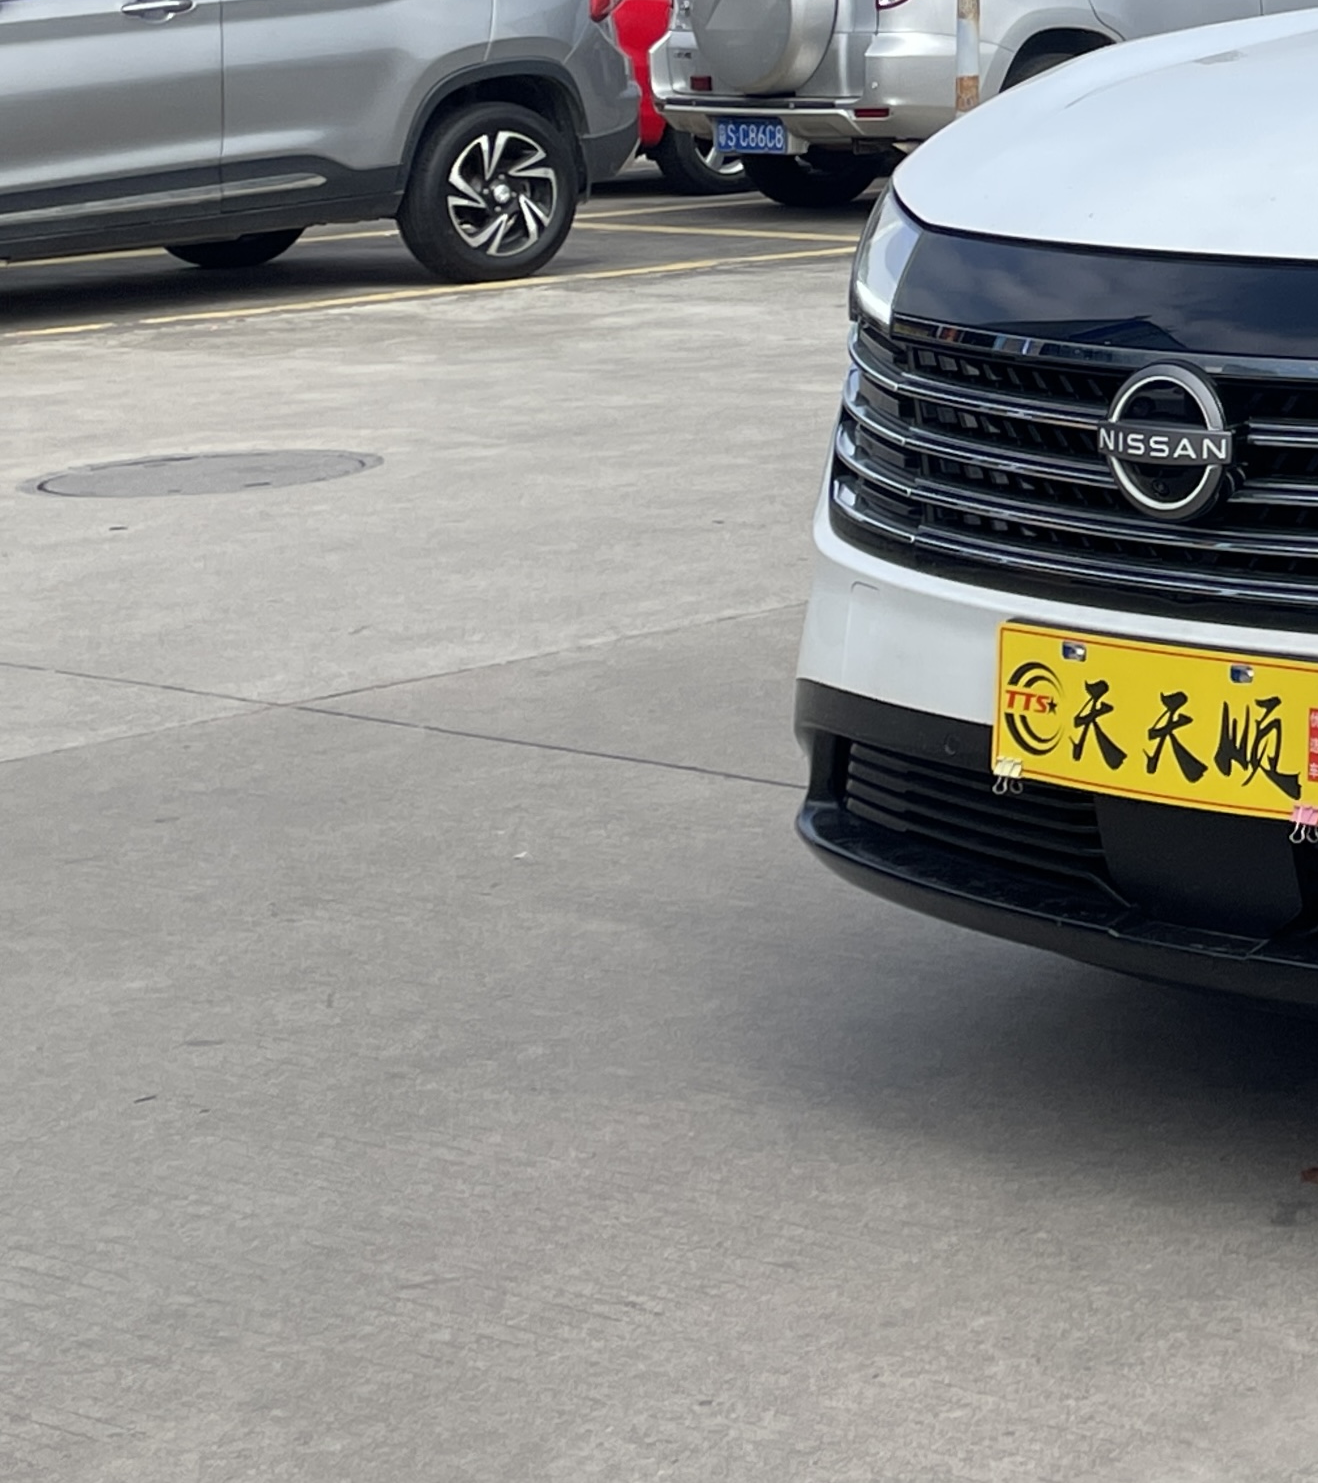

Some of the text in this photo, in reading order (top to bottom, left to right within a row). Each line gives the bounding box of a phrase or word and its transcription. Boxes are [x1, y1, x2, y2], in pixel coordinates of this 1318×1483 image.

[1099, 426, 1229, 461] NISSAN
[1005, 689, 1050, 714] TTS
[1068, 678, 1302, 801] 天天顺
